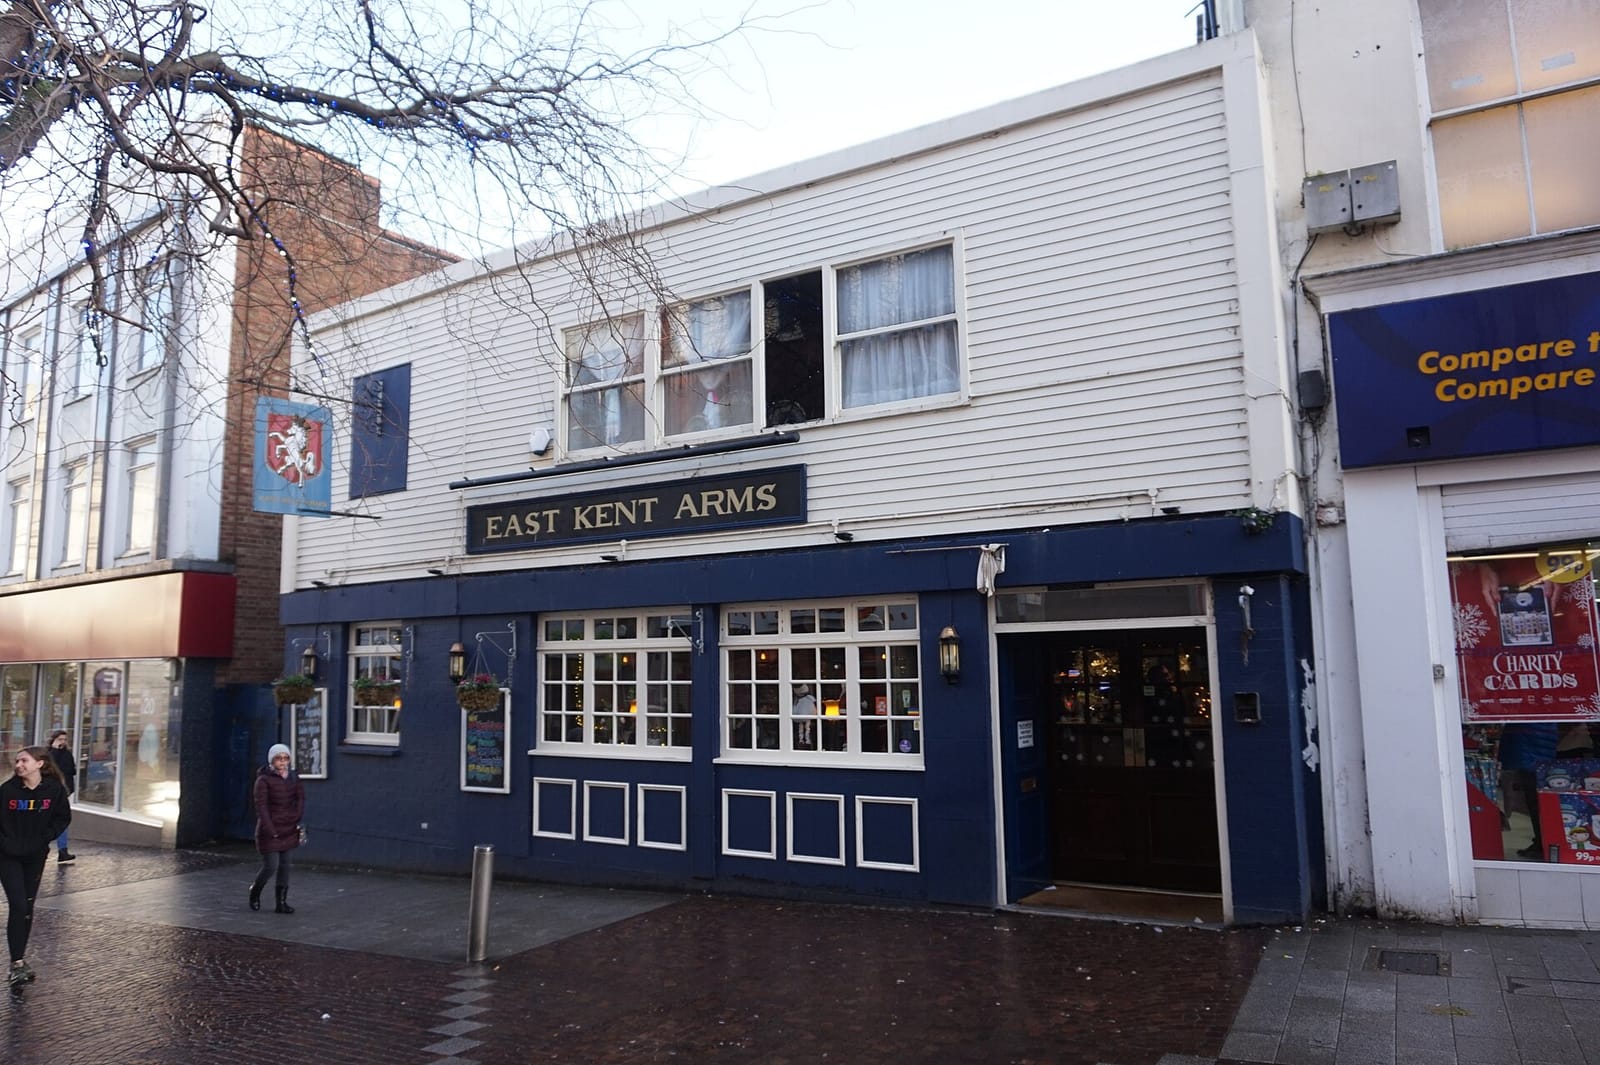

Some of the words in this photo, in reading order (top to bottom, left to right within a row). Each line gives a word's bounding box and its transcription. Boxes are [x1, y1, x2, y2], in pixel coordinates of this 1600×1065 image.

[1418, 339, 1576, 374] Compare
[1435, 368, 1596, 402] Compare
[486, 509, 560, 538] EAST
[573, 497, 658, 530] KENT
[674, 483, 777, 519] ARMS
[1493, 652, 1562, 674] CHARITY
[1484, 673, 1578, 690] CARDS
[1576, 852, 1594, 861] 99p
